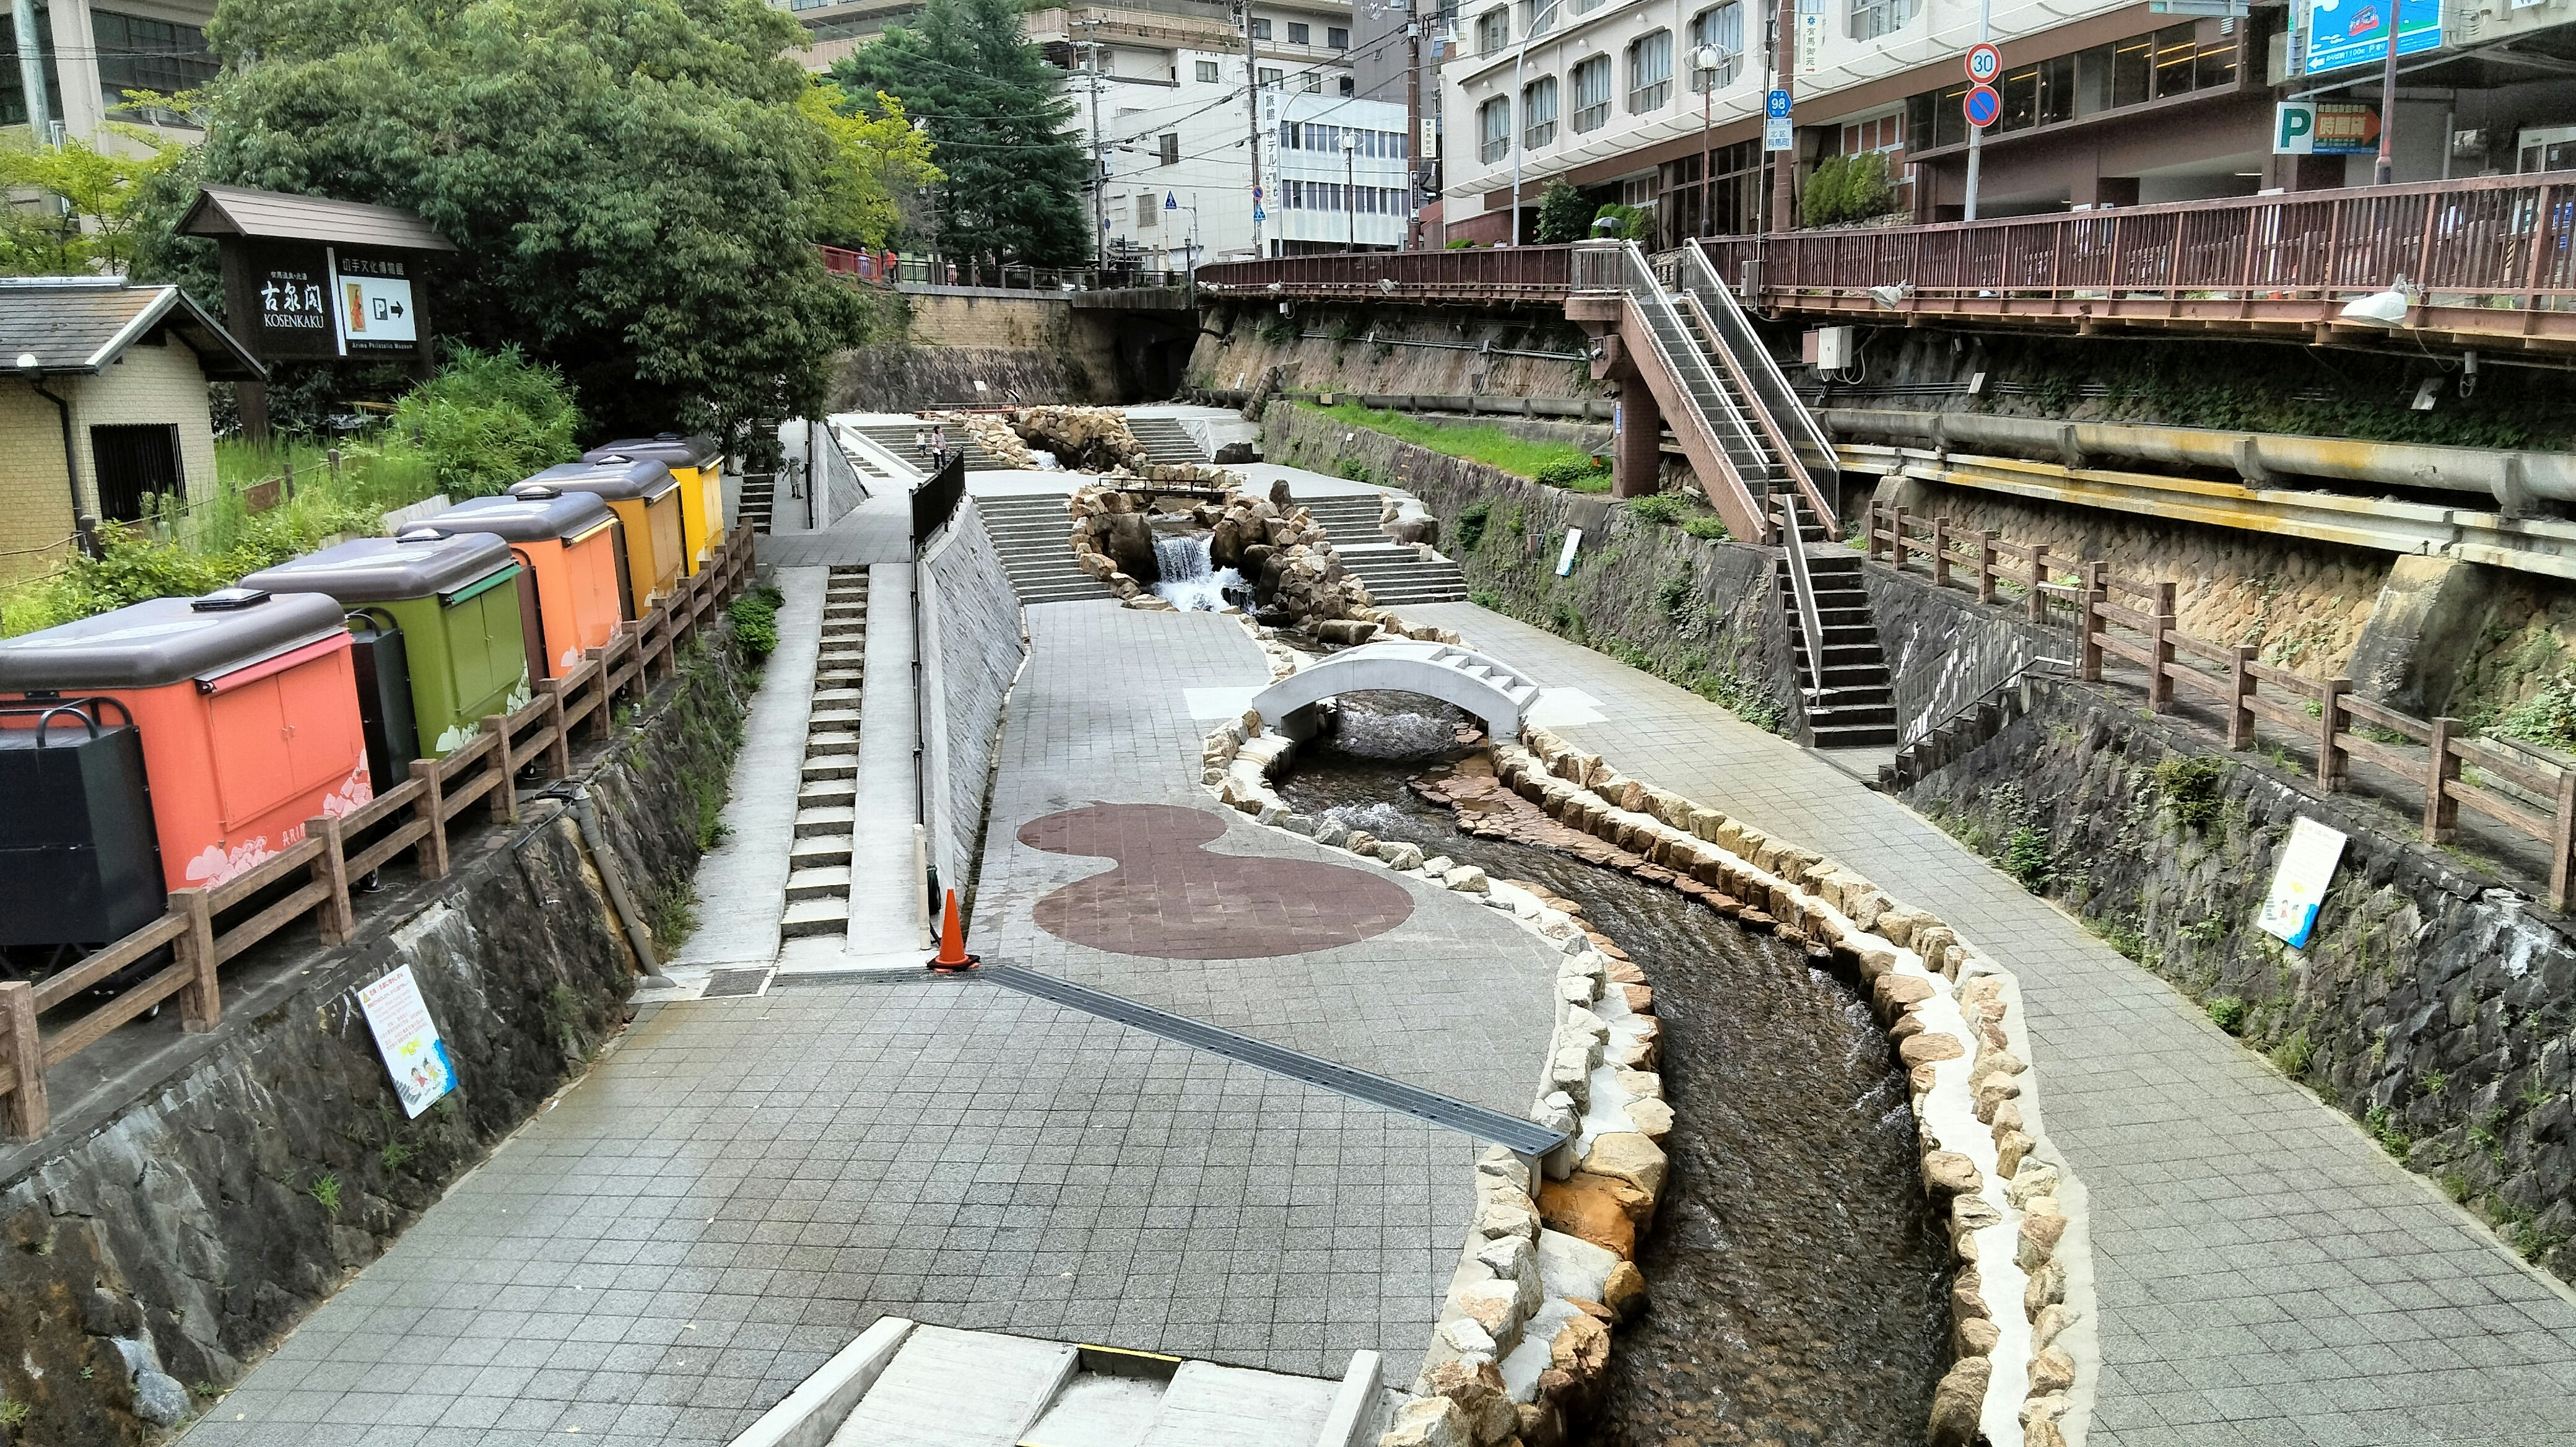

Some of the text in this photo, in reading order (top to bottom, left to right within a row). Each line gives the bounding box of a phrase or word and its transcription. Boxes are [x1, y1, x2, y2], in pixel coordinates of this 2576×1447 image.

[1805, 27, 1816, 66] 有馬御苑
[1973, 55, 1993, 72] 30
[1771, 97, 1786, 110] 98
[2280, 108, 2311, 148] P
[2319, 116, 2367, 135] 時間貸
[260, 281, 323, 314] 古泉閣
[374, 299, 386, 318] P
[264, 313, 324, 328] KOSENKAKU
